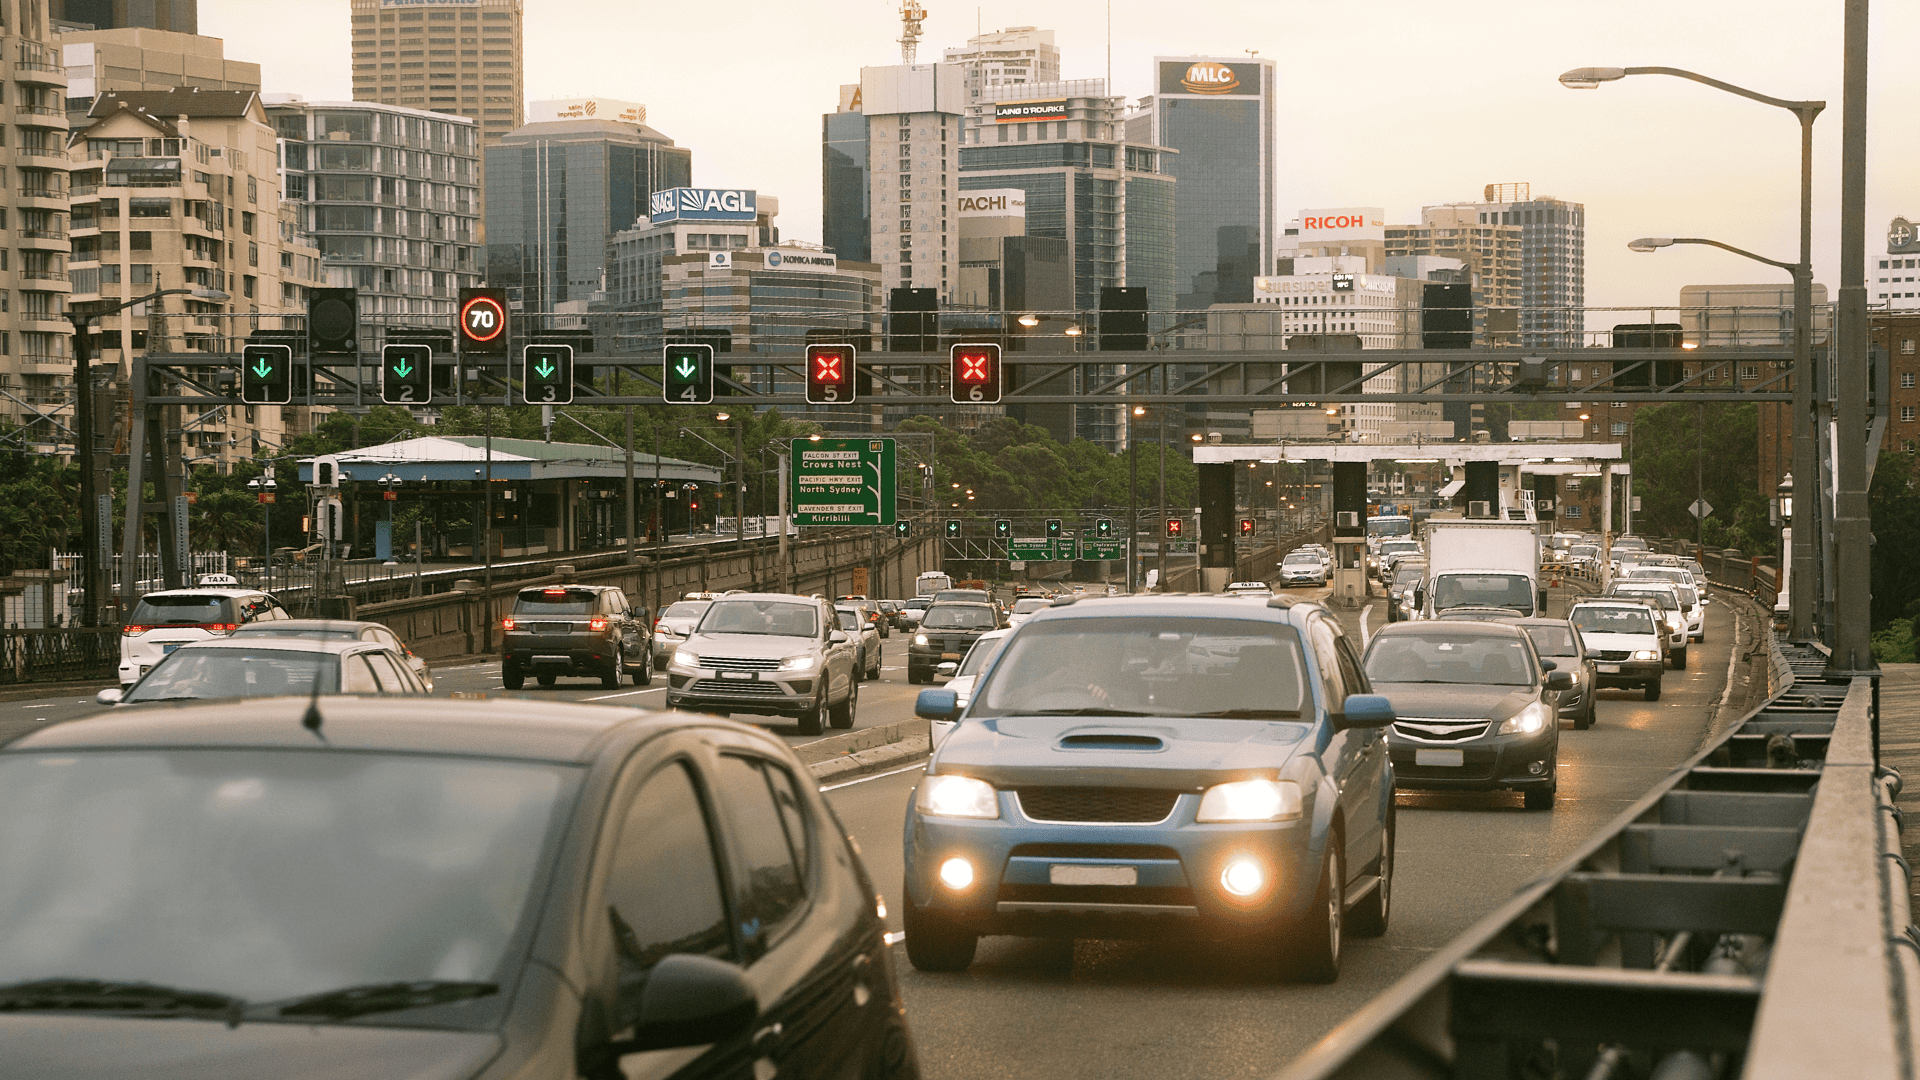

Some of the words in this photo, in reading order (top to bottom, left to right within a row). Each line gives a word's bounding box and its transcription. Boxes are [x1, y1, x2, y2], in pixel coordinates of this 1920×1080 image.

[1190, 67, 1231, 82] MLC
[1023, 105, 1065, 114] O'ROURKE
[660, 192, 676, 214] AGL
[704, 190, 754, 212] AGL
[1305, 215, 1363, 229] RICOH
[783, 255, 810, 264] KONICA
[811, 257, 834, 266] MINOLTA
[470, 310, 493, 328] 70
[262, 385, 269, 401] 1
[400, 385, 413, 401] 2
[542, 385, 556, 402] 3
[680, 385, 697, 402] 4
[824, 385, 838, 401] 5
[969, 385, 984, 401] 6
[829, 486, 861, 494] Sydney
